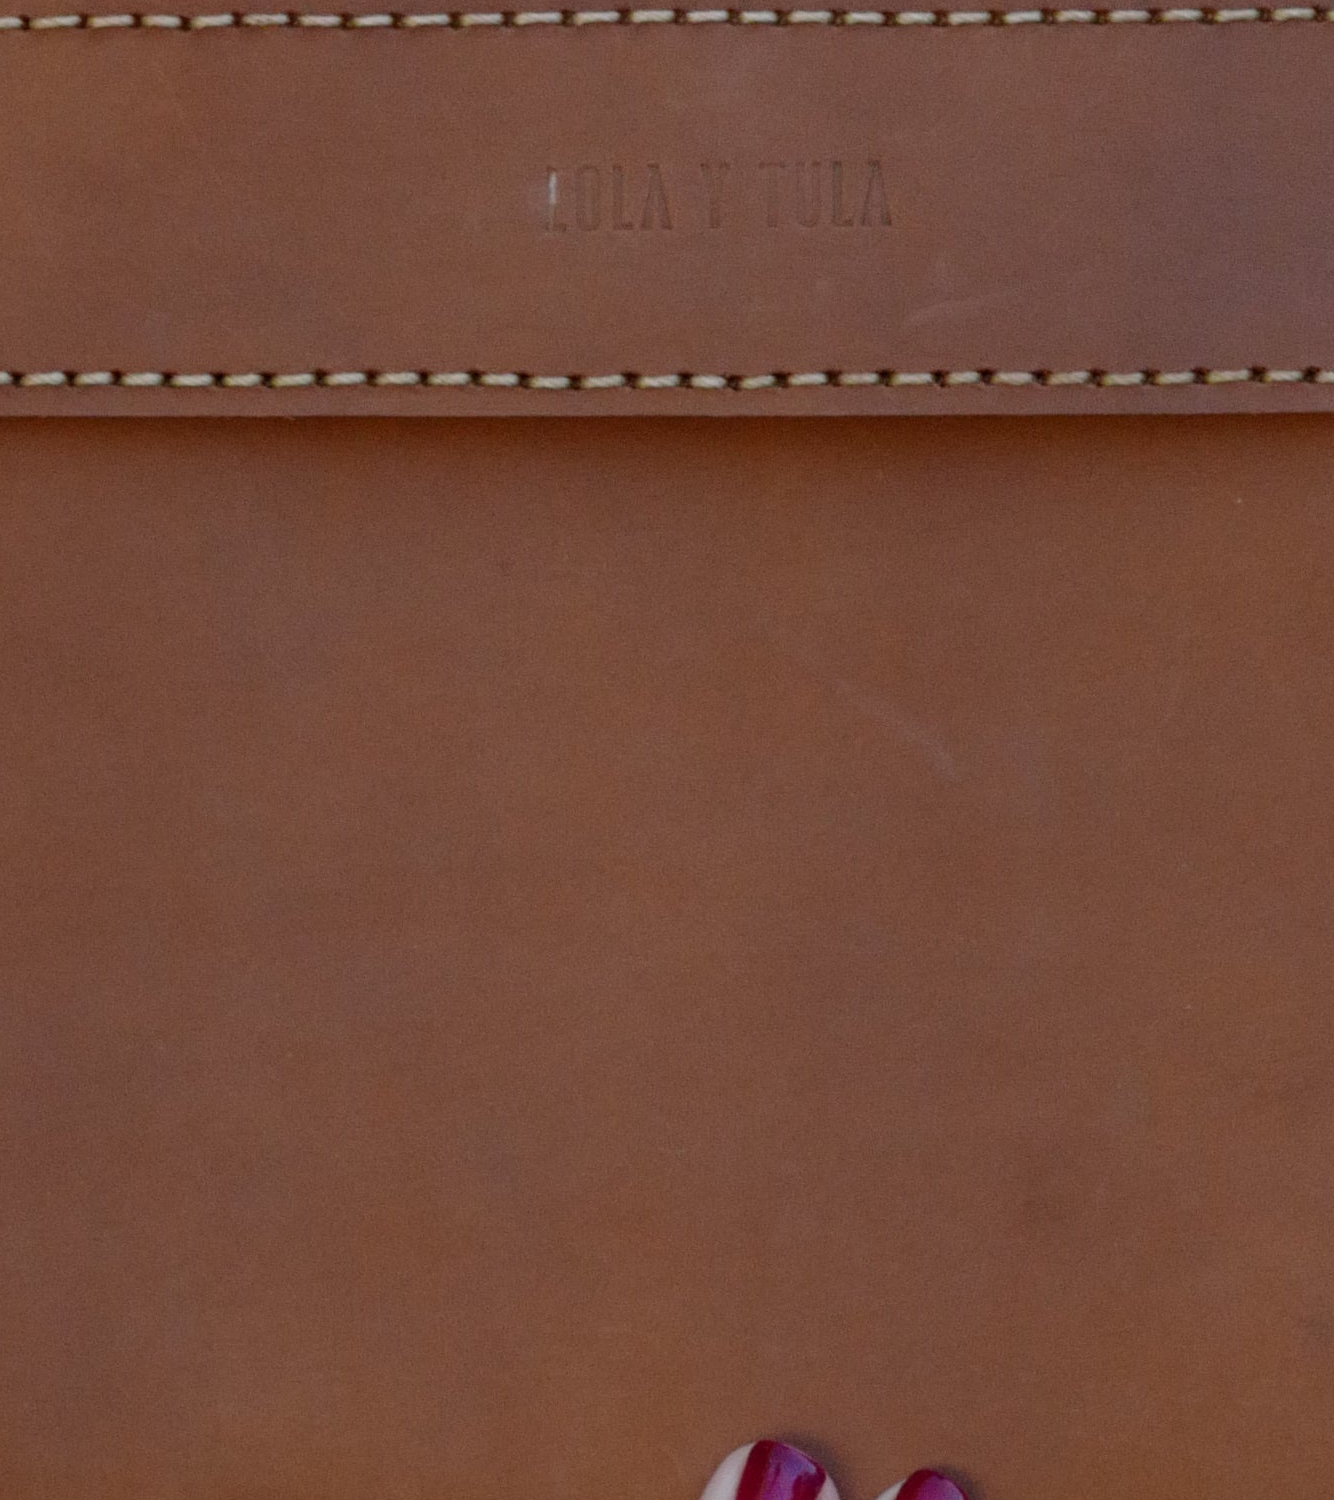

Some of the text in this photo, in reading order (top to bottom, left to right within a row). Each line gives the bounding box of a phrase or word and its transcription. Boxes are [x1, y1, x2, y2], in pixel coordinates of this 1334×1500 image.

[545, 158, 894, 231] LOLA Y TULA
